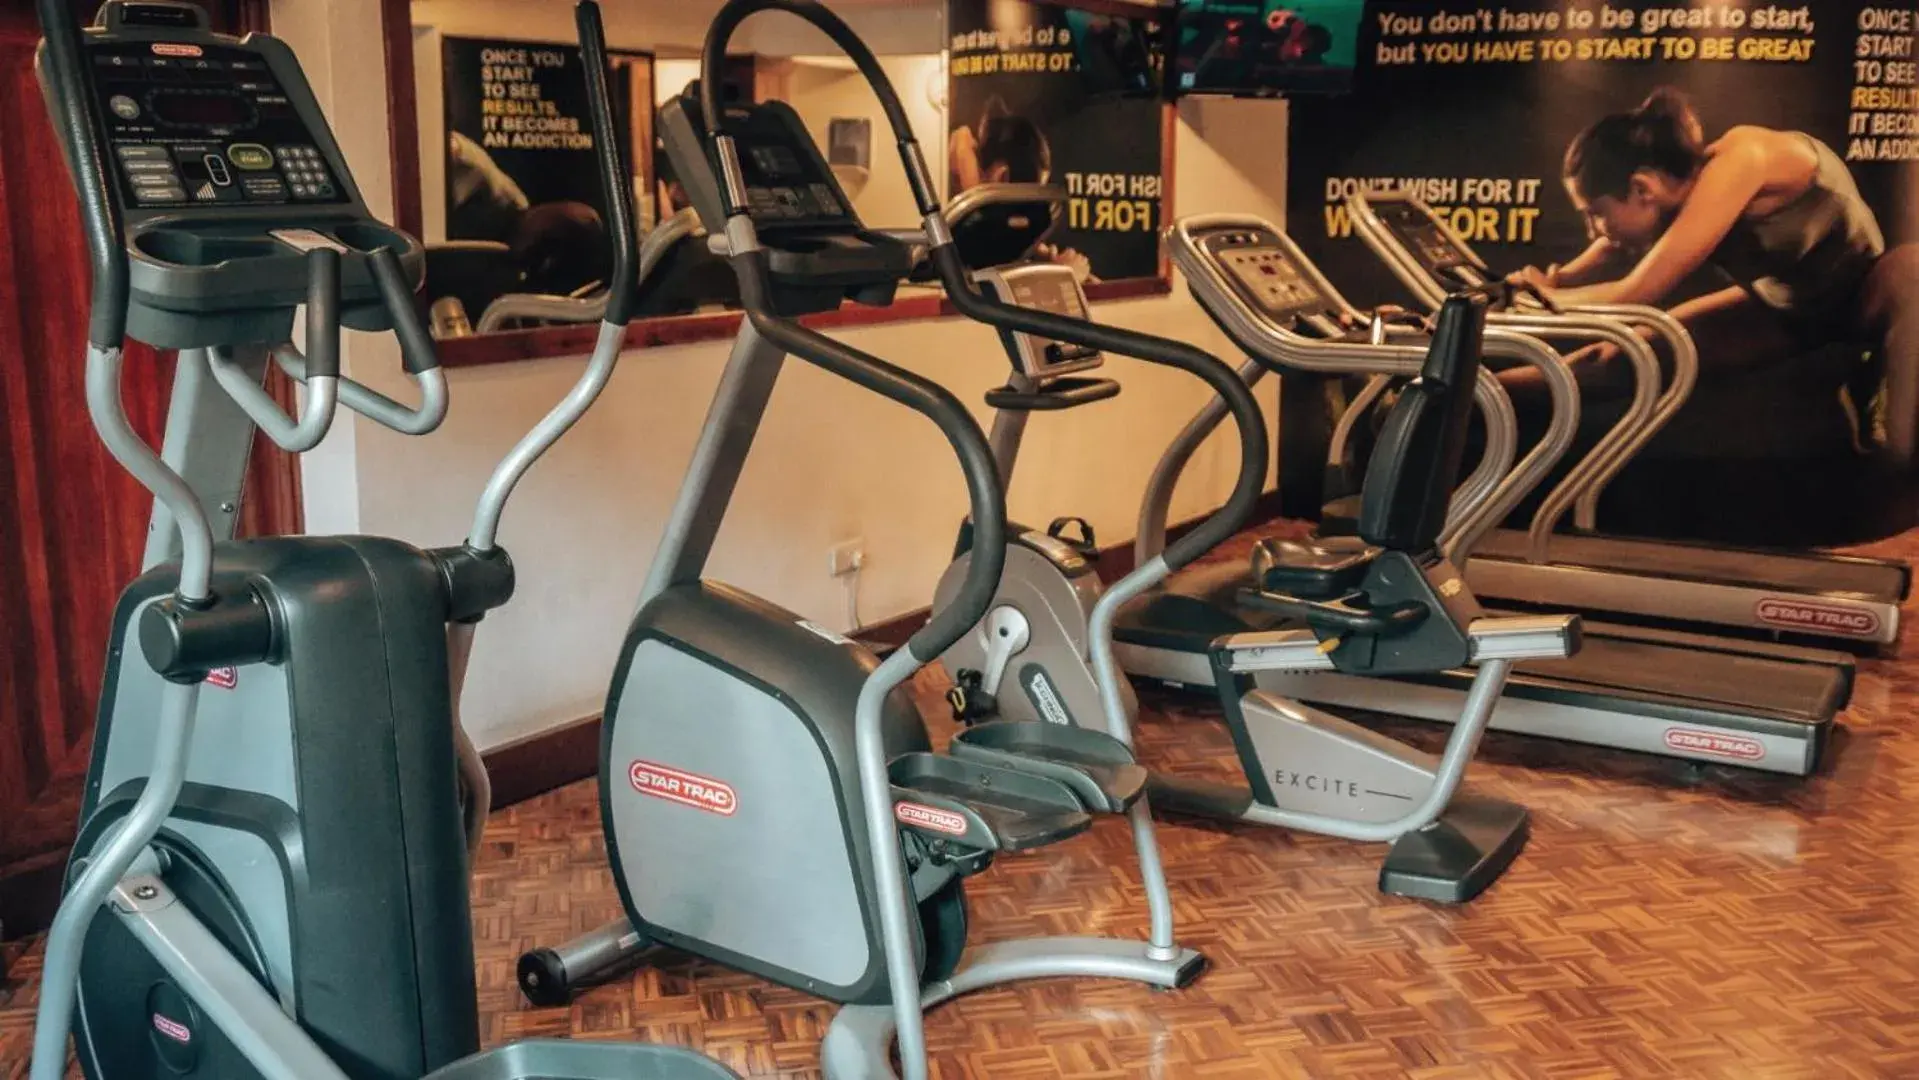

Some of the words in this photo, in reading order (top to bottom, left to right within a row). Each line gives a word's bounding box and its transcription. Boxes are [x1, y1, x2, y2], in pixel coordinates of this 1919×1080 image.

[1378, 12, 1423, 35] You
[1429, 9, 1493, 34] don't
[1500, 7, 1560, 31] have
[1567, 7, 1594, 30] to
[1601, 5, 1635, 29] be
[1641, 6, 1711, 34] great
[1719, 5, 1746, 28] to
[1751, 5, 1815, 34] start,
[1858, 7, 1911, 31] ONCE
[1376, 42, 1416, 64] but
[1421, 41, 1469, 63] YOU
[1473, 40, 1533, 62] HAVE
[1539, 40, 1572, 61] TO
[1575, 38, 1657, 61] START
[1661, 37, 1696, 59] TO
[1700, 37, 1735, 59] BE
[1738, 38, 1815, 60] GREAT
[1855, 34, 1914, 57] START
[481, 48, 527, 65] ONCE
[532, 51, 565, 67] YOU
[482, 66, 533, 80] START
[1853, 60, 1882, 83] TO
[1884, 61, 1917, 83] SEE
[482, 82, 506, 98] TO
[509, 83, 540, 98] SEE
[483, 116, 497, 131] IT
[502, 116, 578, 132] BECOMES
[1849, 113, 1870, 134] IT
[1873, 113, 1919, 134] BECO
[484, 132, 509, 147] AN
[512, 133, 593, 149] ADDICTION
[1845, 138, 1877, 160] AN
[1462, 178, 1512, 203] FOR
[1516, 179, 1541, 203] IT
[1507, 208, 1540, 242] IT
[1762, 606, 1814, 621] STAR
[1814, 612, 1869, 627] TRAC
[1670, 734, 1712, 748] STAR
[1713, 740, 1759, 754] TRAC
[632, 771, 680, 790] STAR
[681, 780, 728, 805] TRAC
[1275, 769, 1359, 797] EXCITE
